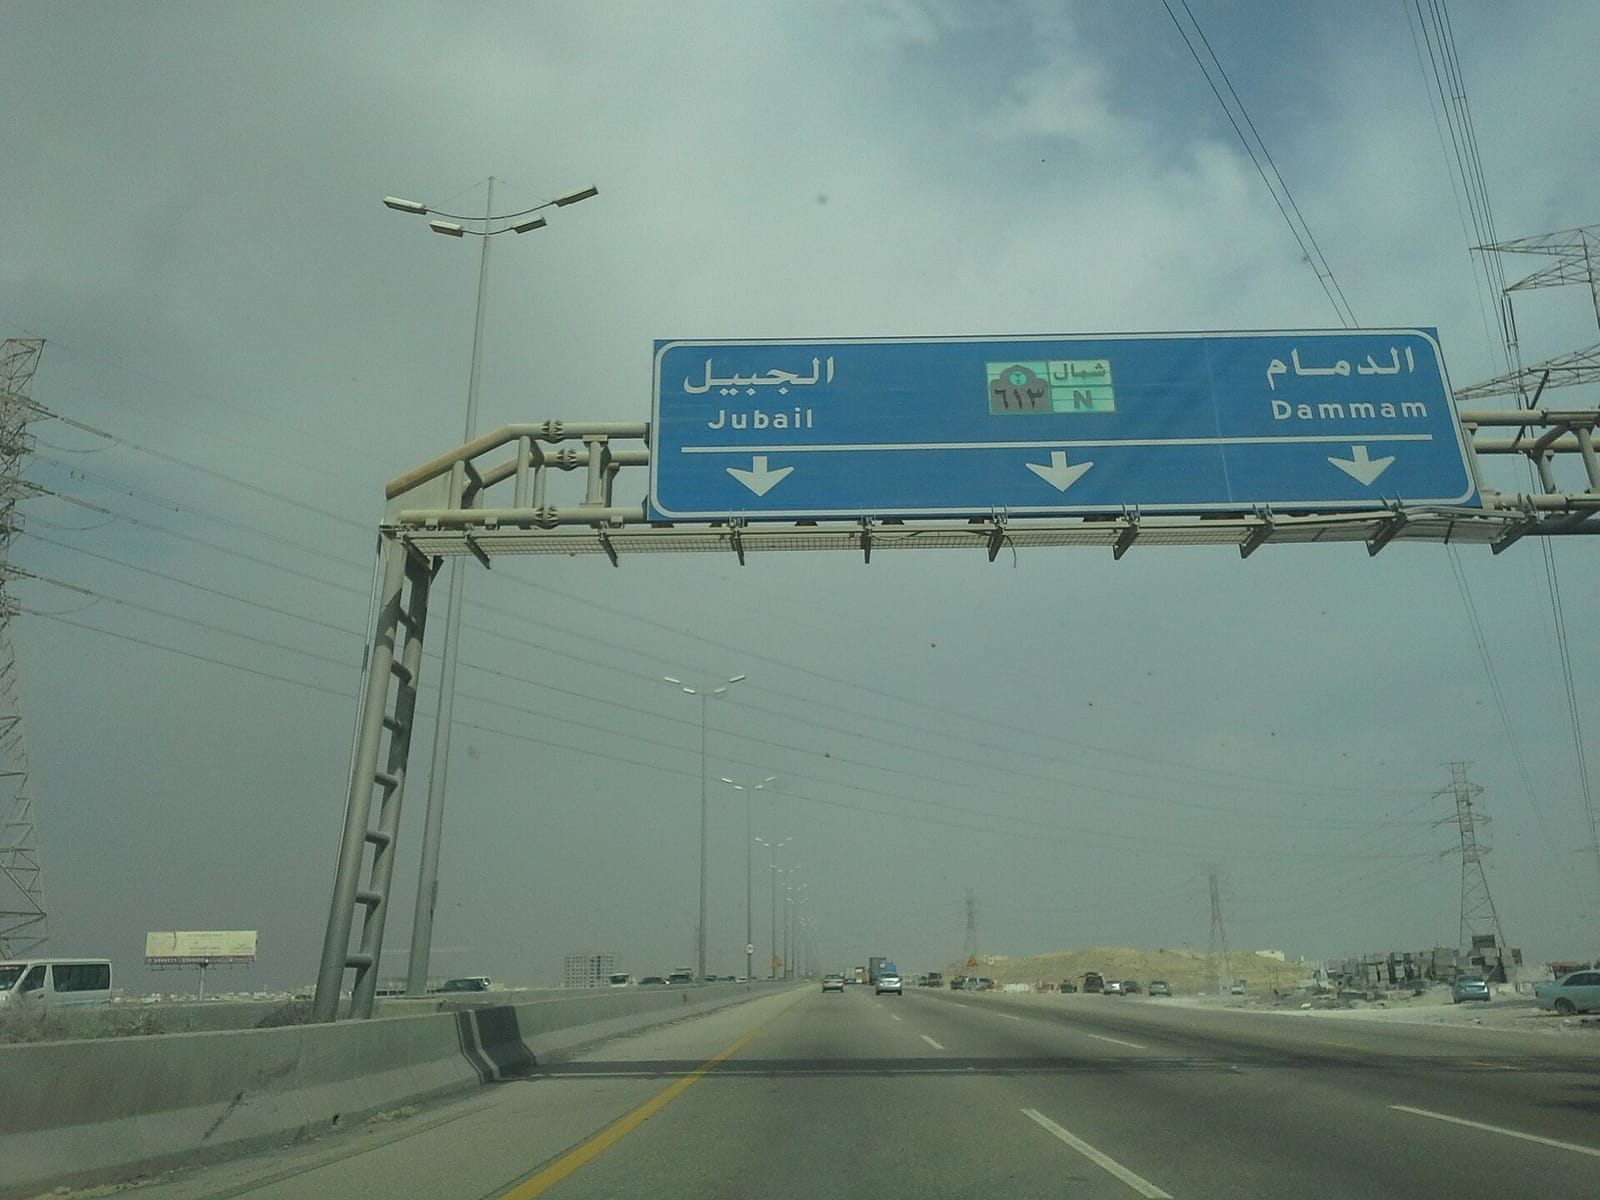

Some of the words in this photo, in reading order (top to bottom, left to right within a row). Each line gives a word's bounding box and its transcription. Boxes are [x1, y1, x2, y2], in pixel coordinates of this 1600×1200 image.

[683, 356, 834, 396] الجبيل
[1053, 363, 1106, 381] شمال
[1266, 346, 1415, 390] الدمام
[1073, 390, 1093, 409] N
[1271, 400, 1428, 420] Dammam
[708, 407, 814, 430] Jubail
